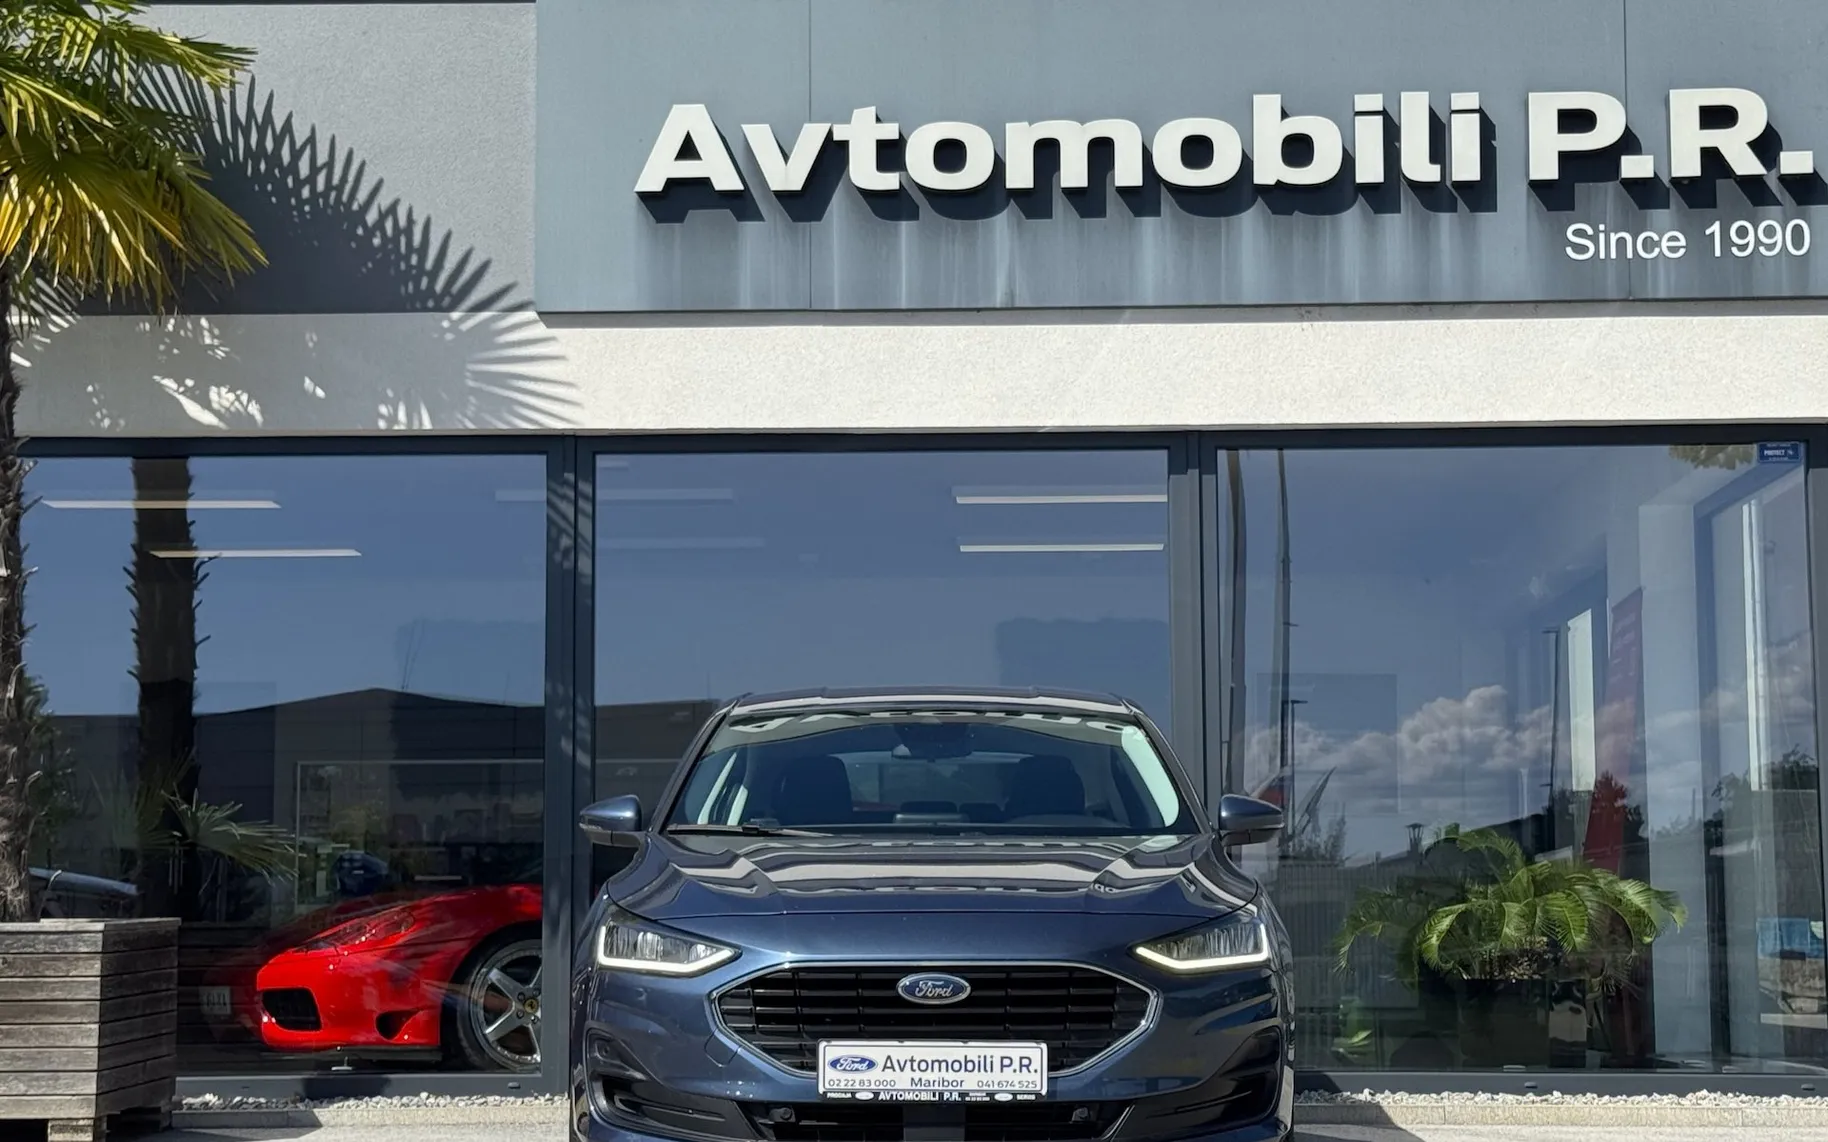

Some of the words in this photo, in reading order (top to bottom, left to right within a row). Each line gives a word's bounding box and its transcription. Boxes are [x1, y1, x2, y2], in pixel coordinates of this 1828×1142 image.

[633, 92, 1481, 193] Avtomobili
[1528, 88, 1815, 181] P.R.
[1564, 222, 1687, 260] Since
[1703, 218, 1812, 258] 1990
[915, 981, 954, 997] Ford
[836, 1057, 869, 1071] Ford
[881, 1054, 994, 1073] Avtomobili
[1000, 1056, 1038, 1073] P.R.
[828, 1079, 842, 1087] 02
[843, 1079, 856, 1087] 22
[858, 1079, 872, 1087] 83
[874, 1079, 896, 1087] 000
[910, 1077, 965, 1088] Maribor
[977, 1080, 995, 1088] 041
[997, 1080, 1016, 1088] 674
[1018, 1080, 1037, 1089] 525
[878, 1091, 939, 1101] AVTOMOBILI
[943, 1092, 962, 1101] P.R.
